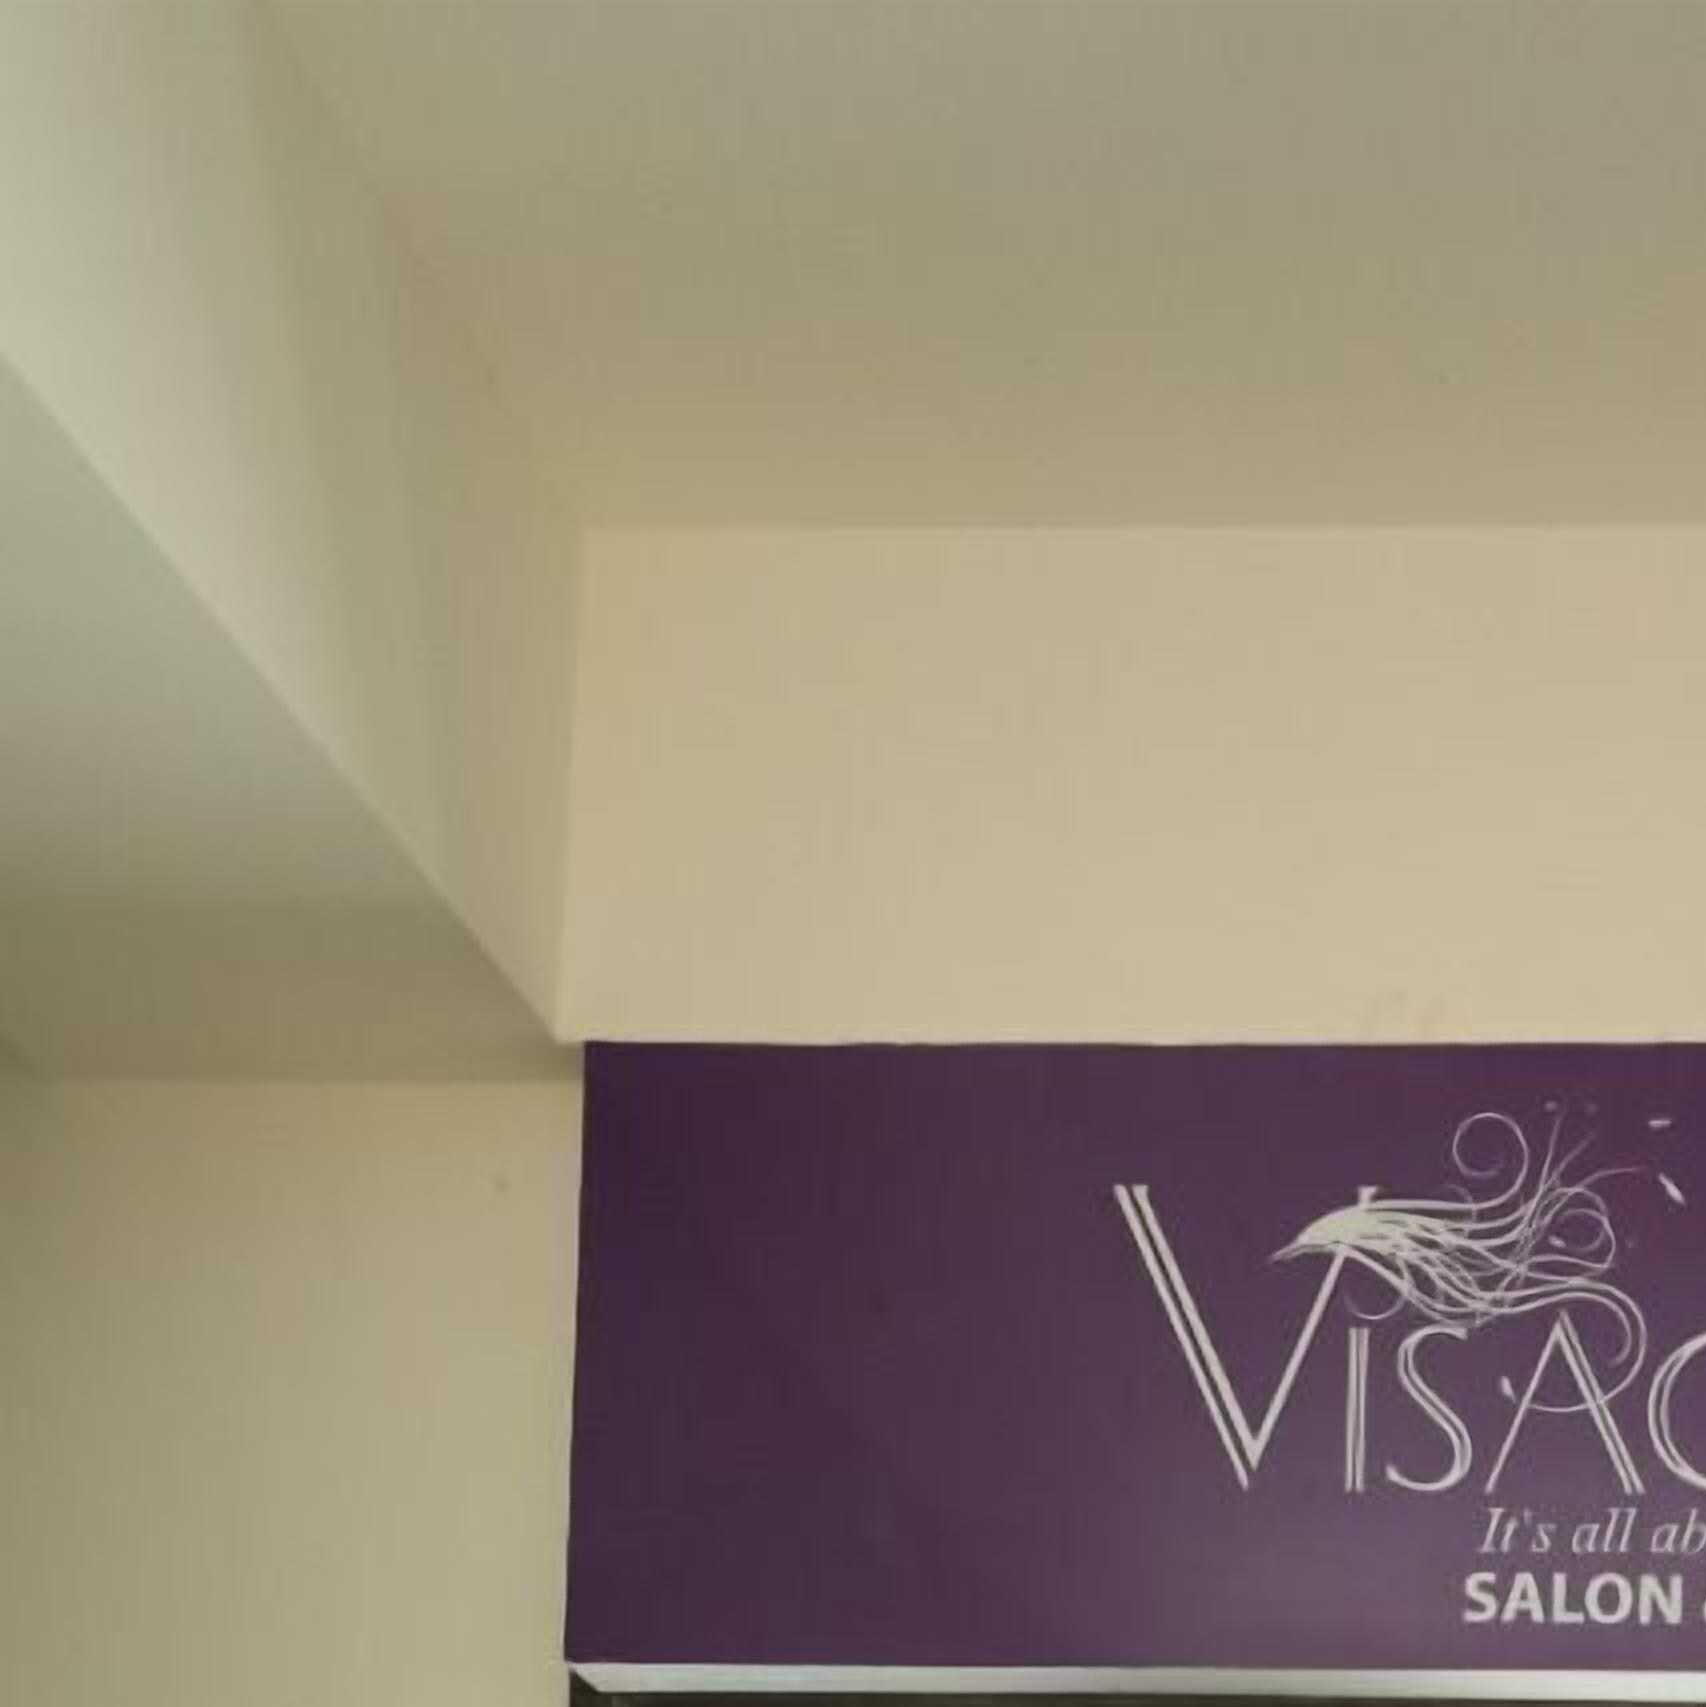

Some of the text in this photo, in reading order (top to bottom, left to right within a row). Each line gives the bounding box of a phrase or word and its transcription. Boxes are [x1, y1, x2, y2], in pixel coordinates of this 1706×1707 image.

[1478, 1506, 1556, 1554] It's
[1570, 1506, 1636, 1555] all
[1462, 1571, 1683, 1625] SALON
